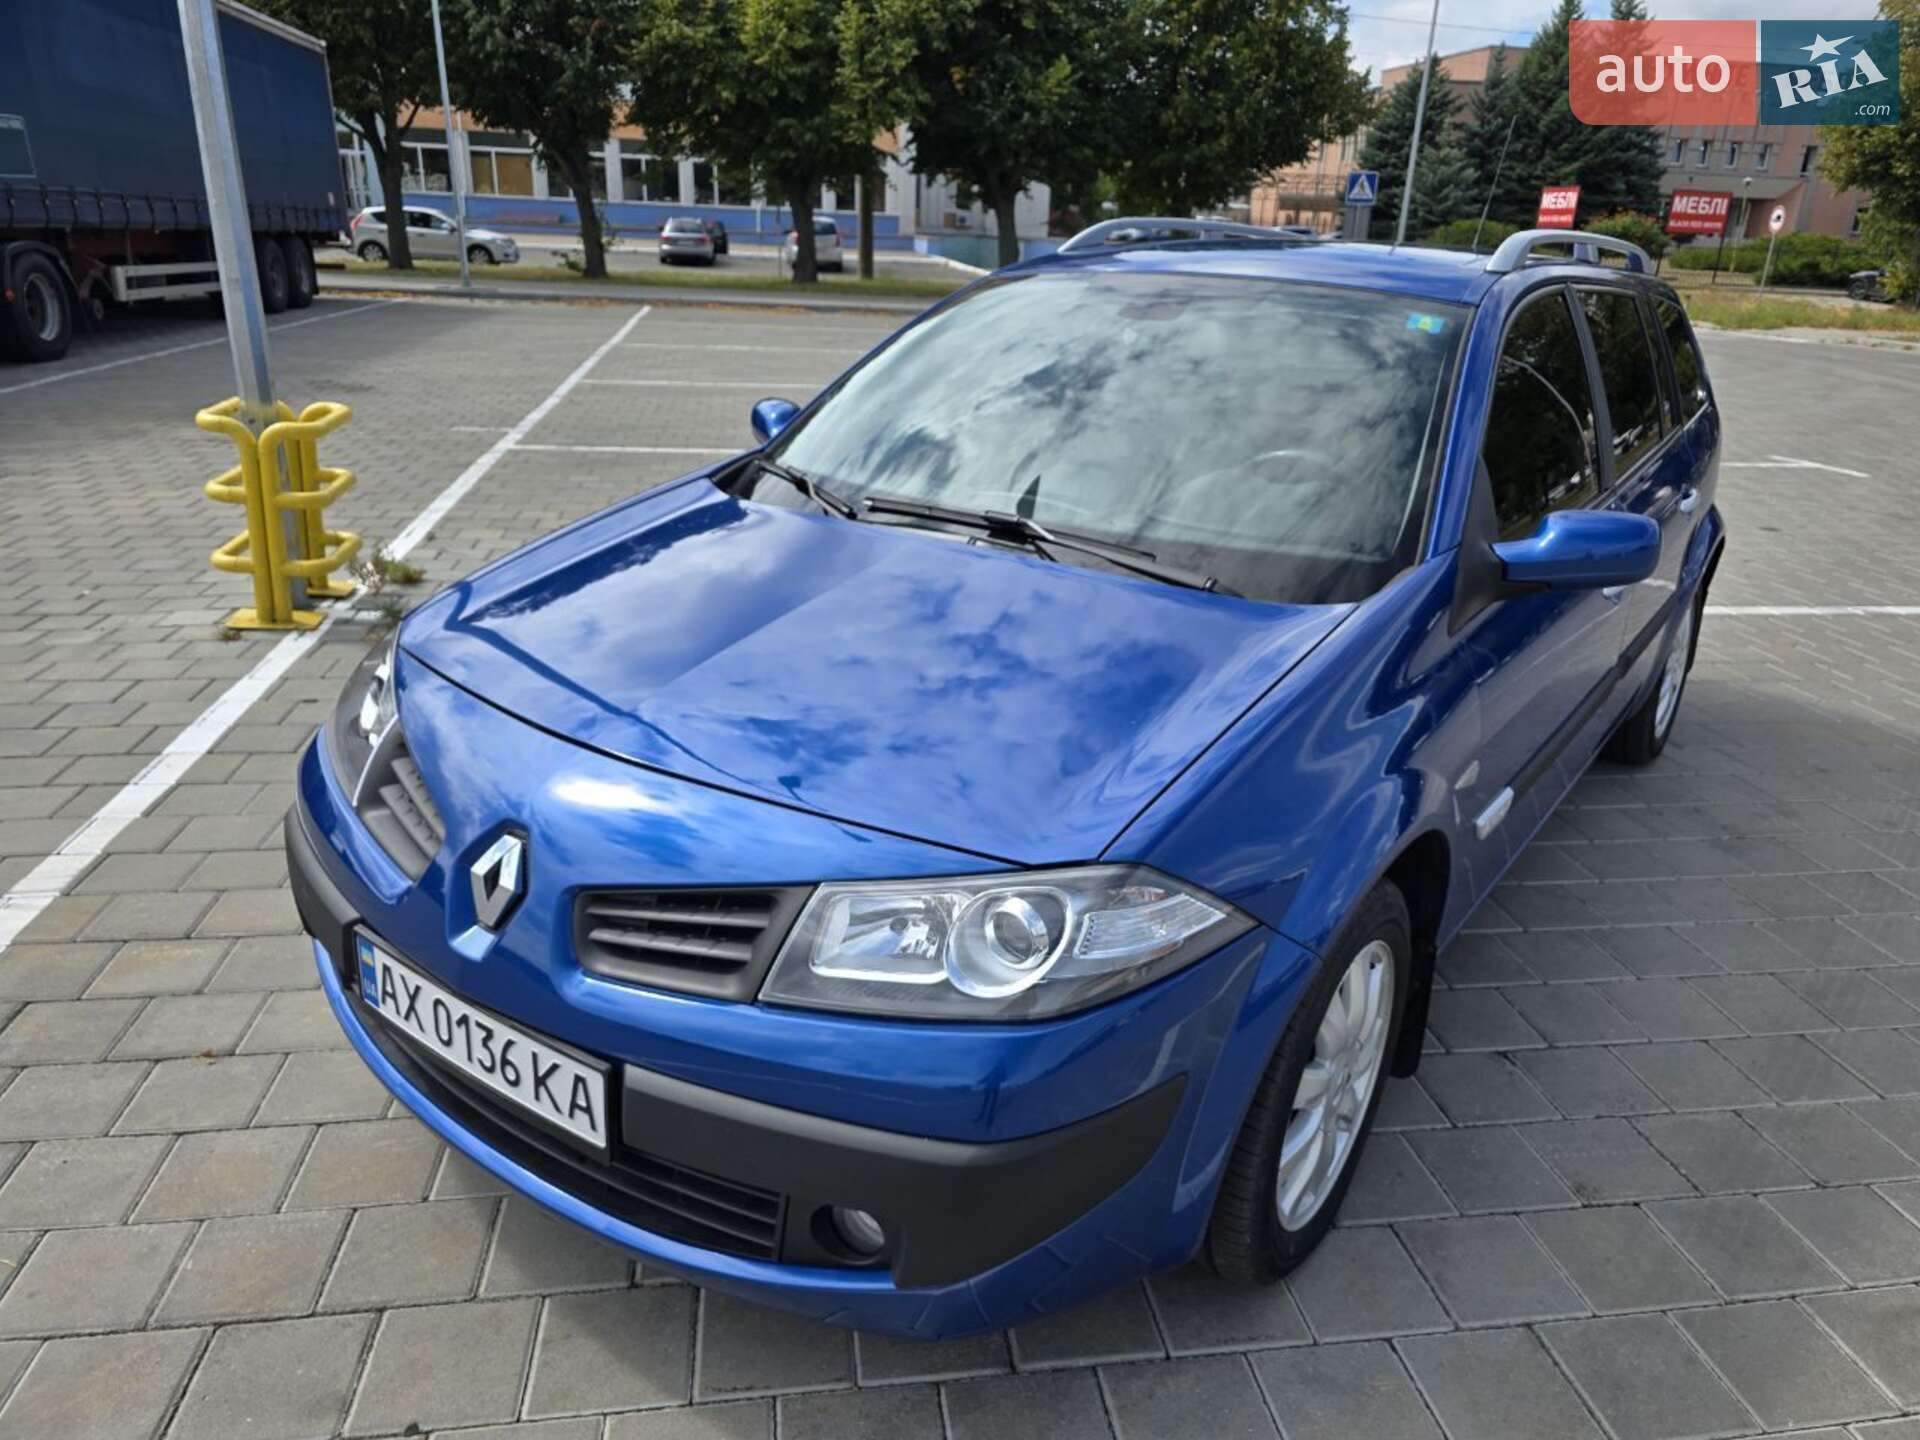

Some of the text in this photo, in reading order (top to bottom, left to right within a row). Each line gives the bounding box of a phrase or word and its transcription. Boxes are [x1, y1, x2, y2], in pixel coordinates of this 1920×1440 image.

[1540, 191, 1578, 209] МЕБЛІ
[1671, 196, 1729, 215] МЕБЛІ
[381, 962, 598, 1132] AX 0136 KA
